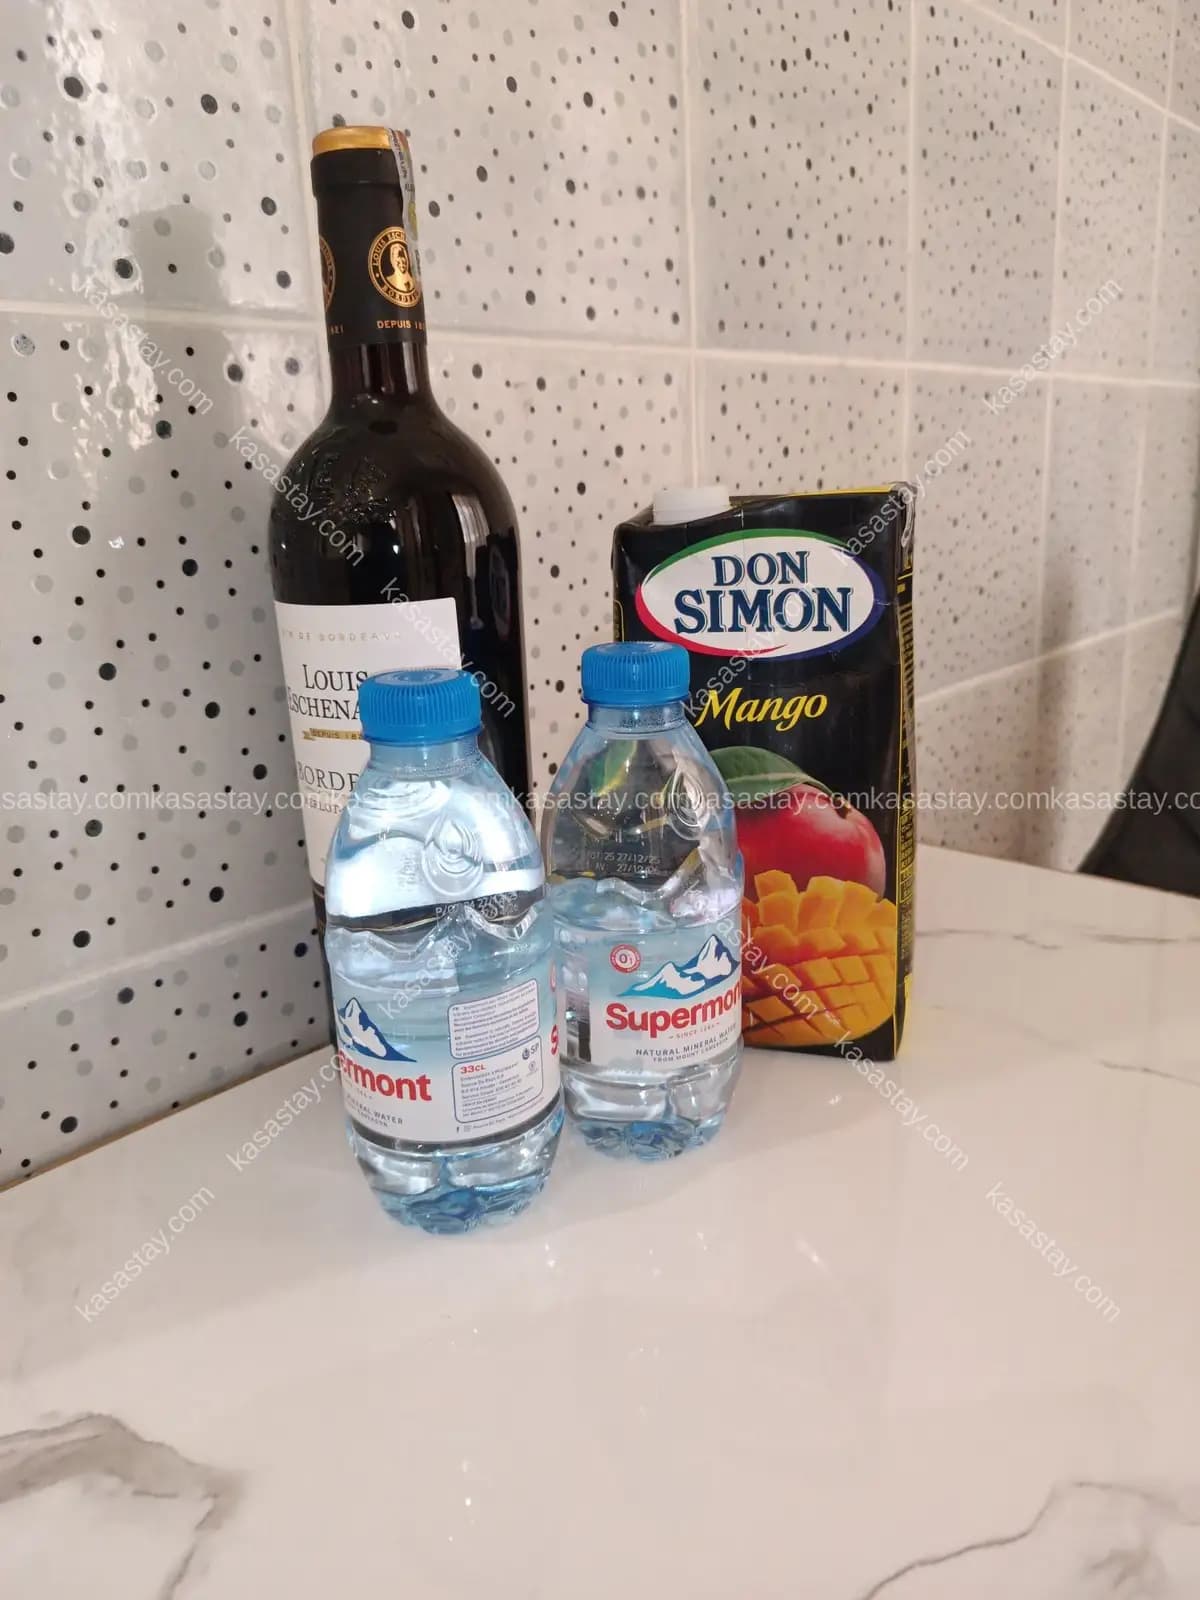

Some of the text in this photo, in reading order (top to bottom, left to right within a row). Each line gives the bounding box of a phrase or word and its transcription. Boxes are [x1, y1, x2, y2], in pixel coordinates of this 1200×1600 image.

[376, 319, 412, 330] DEPUIS
[711, 551, 811, 587] DON
[673, 587, 854, 635] SIMON
[693, 687, 828, 732] Mango
[635, 1048, 681, 1057] NATURAL
